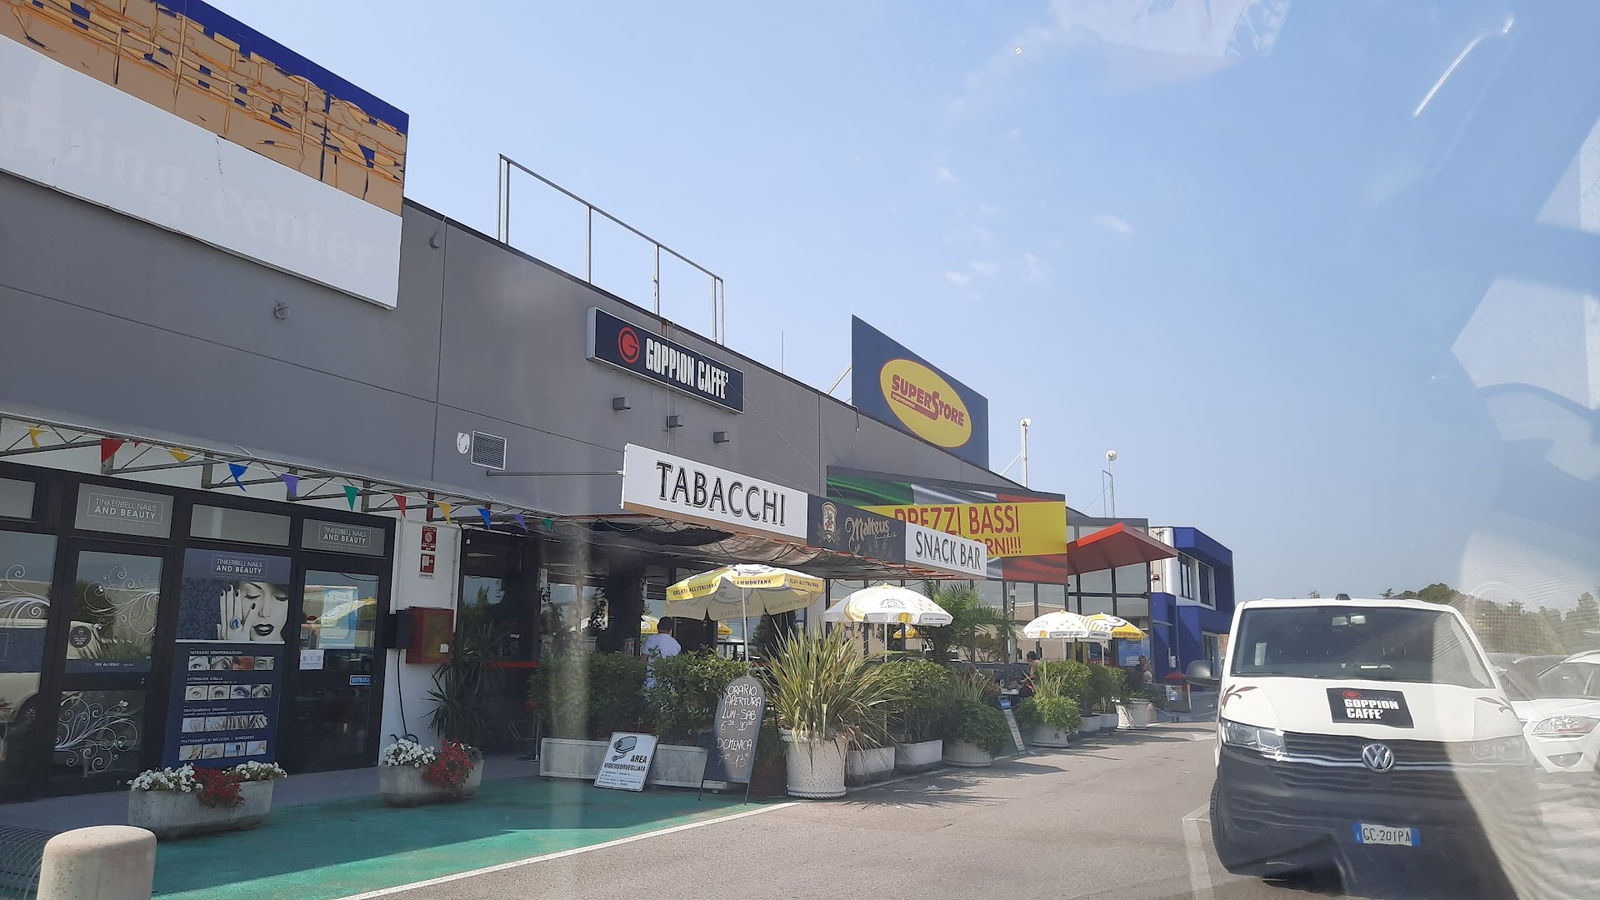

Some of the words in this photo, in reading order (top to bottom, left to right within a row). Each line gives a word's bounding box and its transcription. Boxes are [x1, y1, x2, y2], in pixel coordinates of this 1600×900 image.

[645, 338, 694, 387] GOPPION
[891, 373, 965, 427] SUPERSTORE
[656, 460, 786, 527] TABACCHI
[95, 497, 136, 510] TINKERBELL
[137, 503, 157, 512] NAILS
[95, 506, 117, 515] AND
[120, 508, 156, 520] BEAUTY
[968, 505, 1020, 535] BASSI
[341, 535, 366, 545] BEAUTY
[915, 531, 957, 565] SNACK
[960, 543, 982, 571] BAR
[216, 564, 233, 572] AND
[235, 566, 263, 574] BEAUTY
[727, 683, 758, 697] ORARIO
[724, 694, 762, 708] APERTURA
[1343, 698, 1400, 710] GOPPION
[1346, 707, 1384, 720] CAFFE'
[716, 737, 753, 751] DOMENICA
[630, 754, 648, 764] AREA
